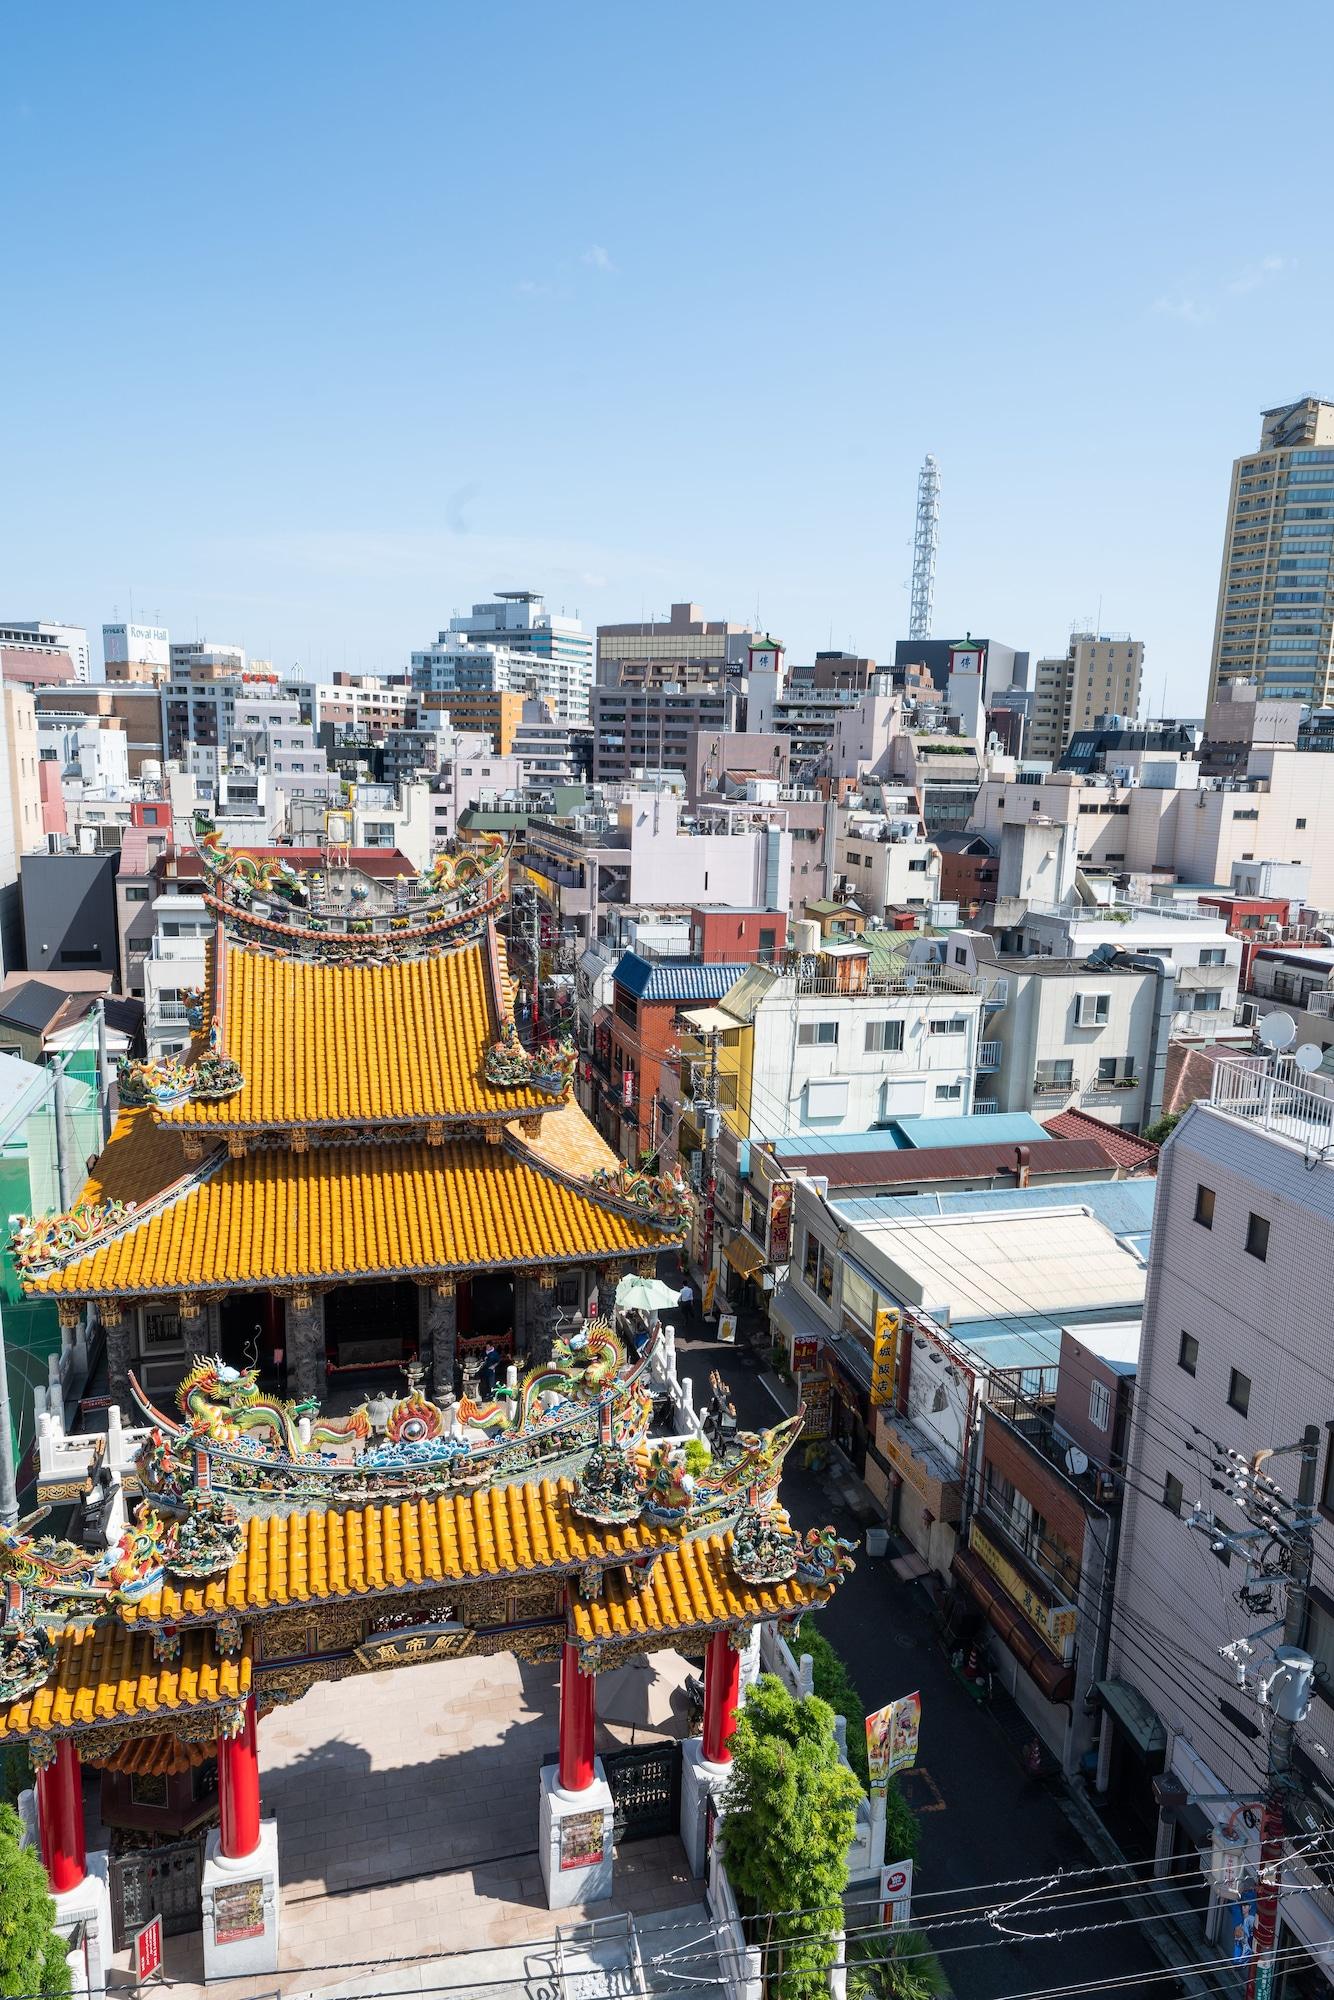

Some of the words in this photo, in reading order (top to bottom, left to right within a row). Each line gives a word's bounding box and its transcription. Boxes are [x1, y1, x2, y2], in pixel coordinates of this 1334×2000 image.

[130, 627, 151, 639] Royal
[153, 630, 167, 641] Hall
[877, 1328, 892, 1392] 長城飯店
